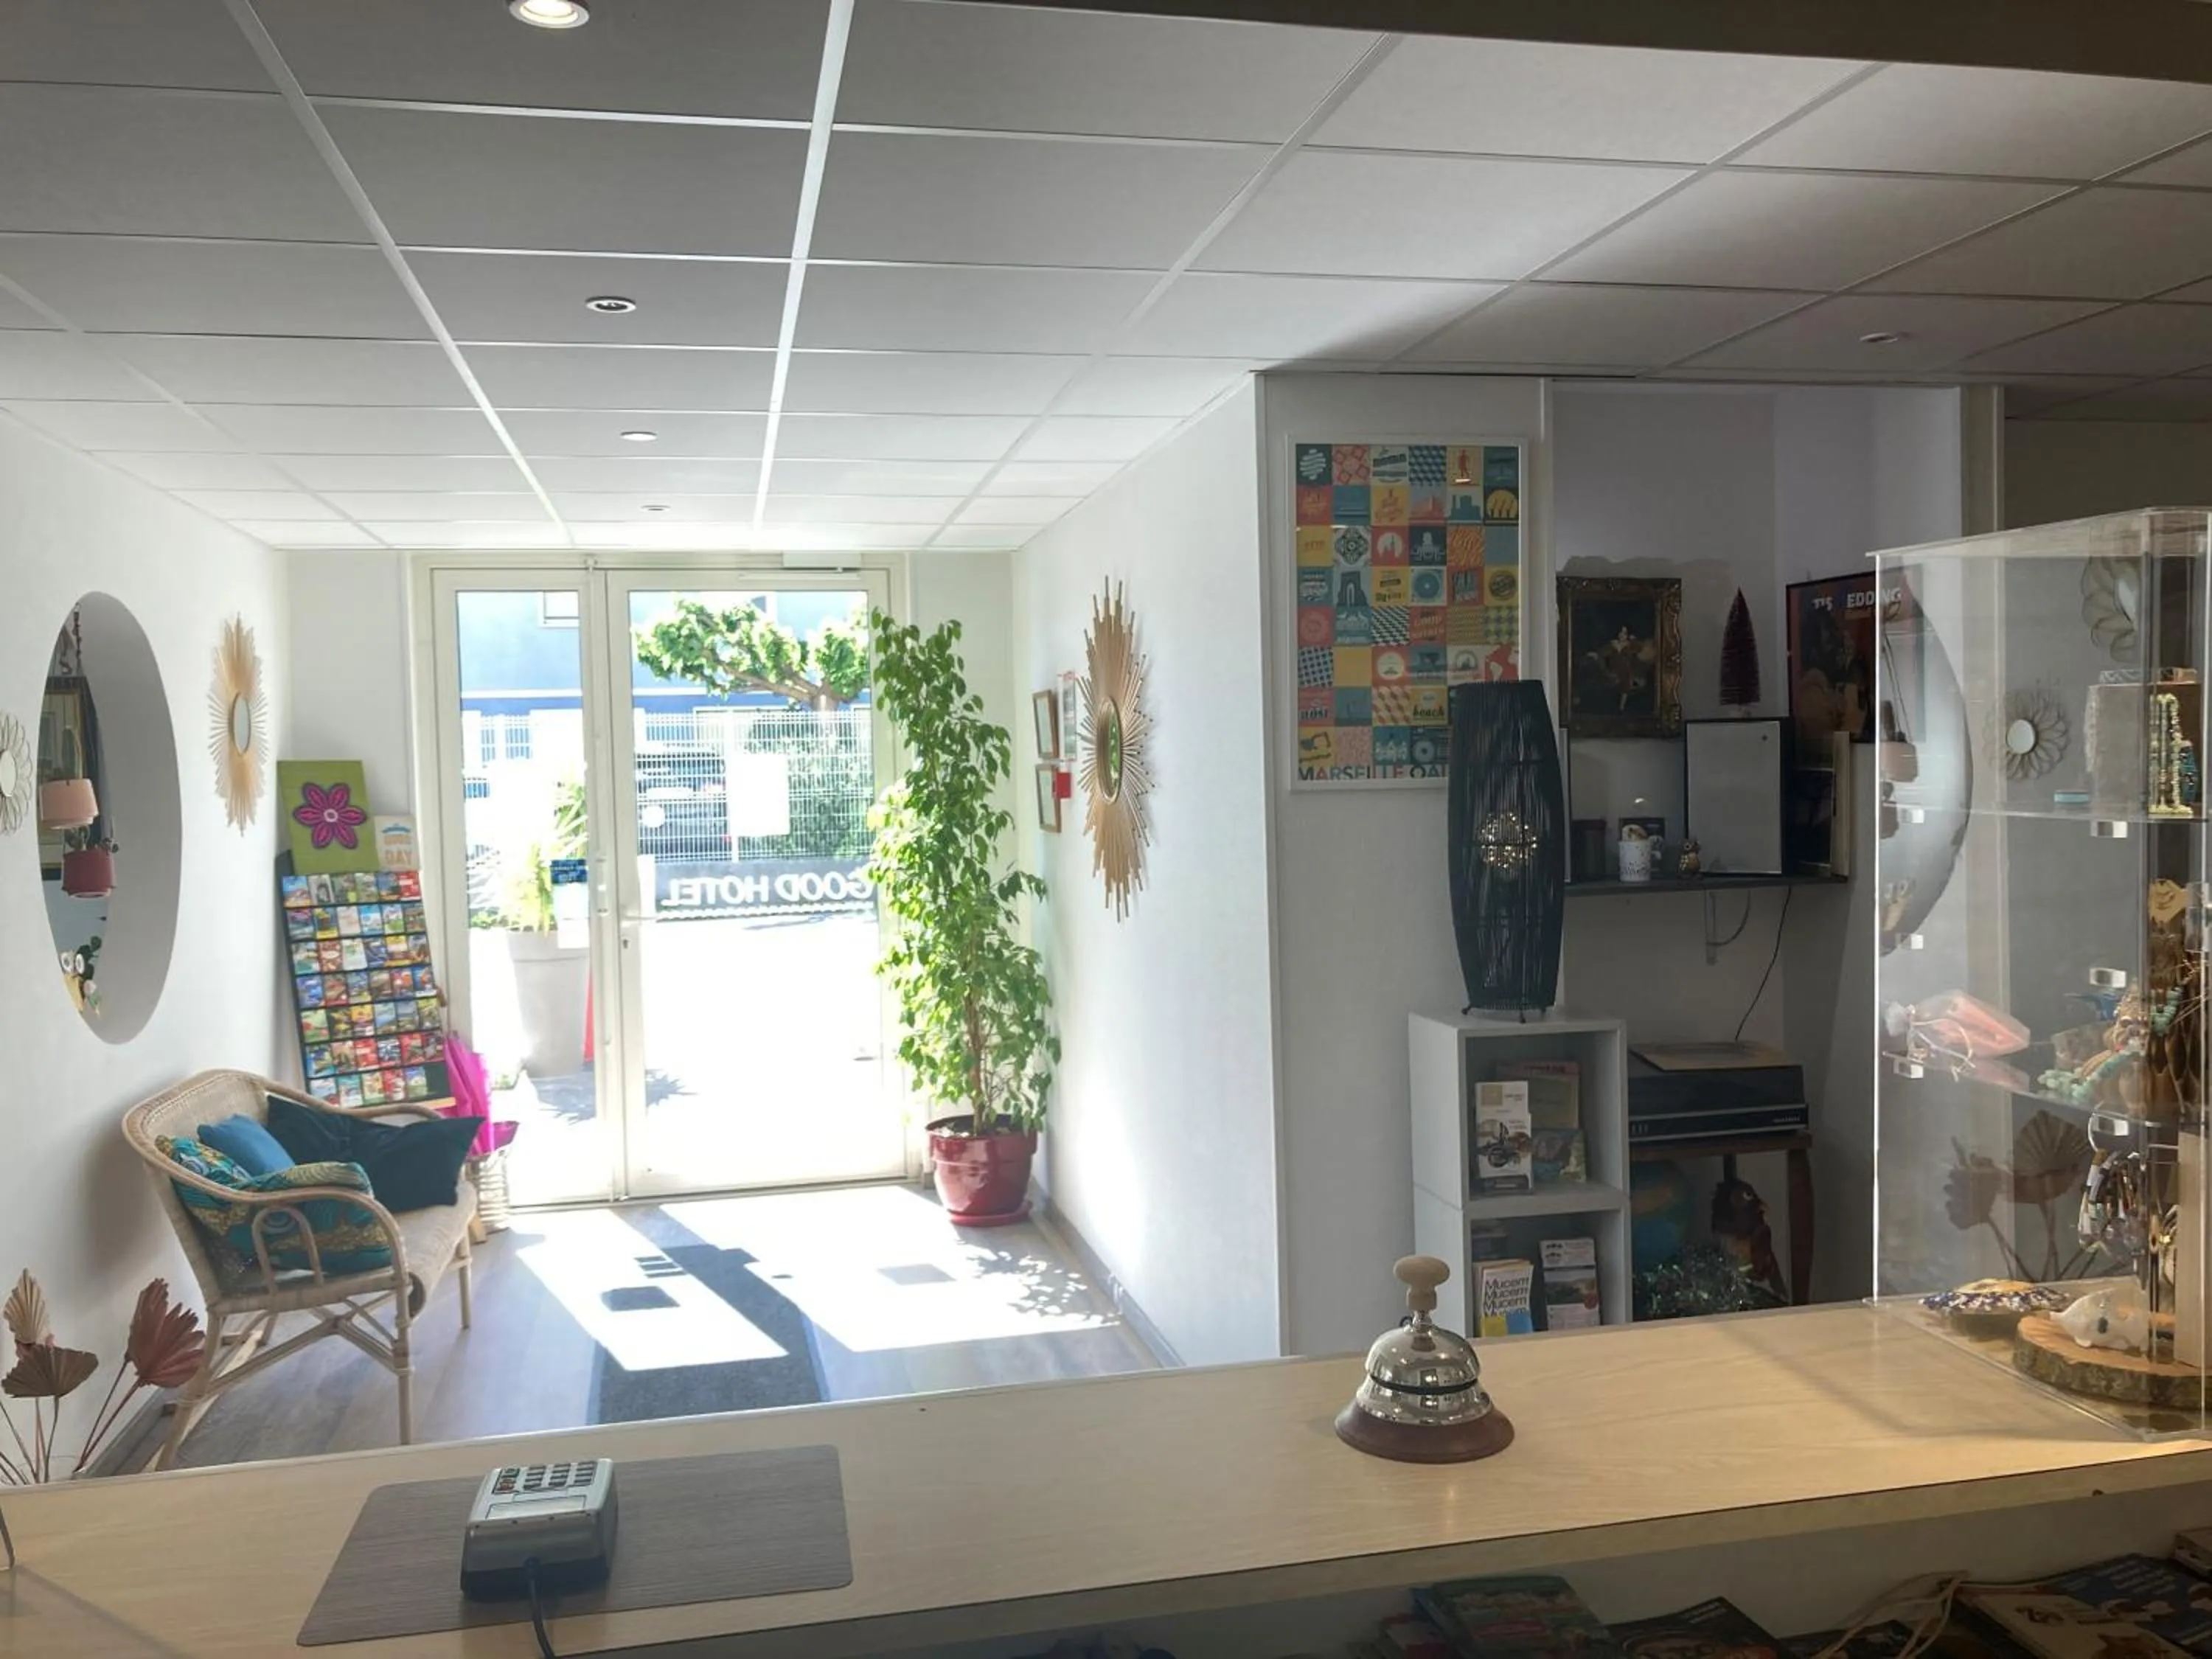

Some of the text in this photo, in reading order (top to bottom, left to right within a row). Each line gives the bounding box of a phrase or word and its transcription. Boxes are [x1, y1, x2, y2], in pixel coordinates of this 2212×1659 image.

[1846, 587, 1902, 608] EDDNG
[385, 849, 411, 865] DAY
[1485, 1277, 1529, 1289] Mucem
[1484, 1287, 1528, 1298] Mucem
[1484, 1297, 1526, 1309] Mucem
